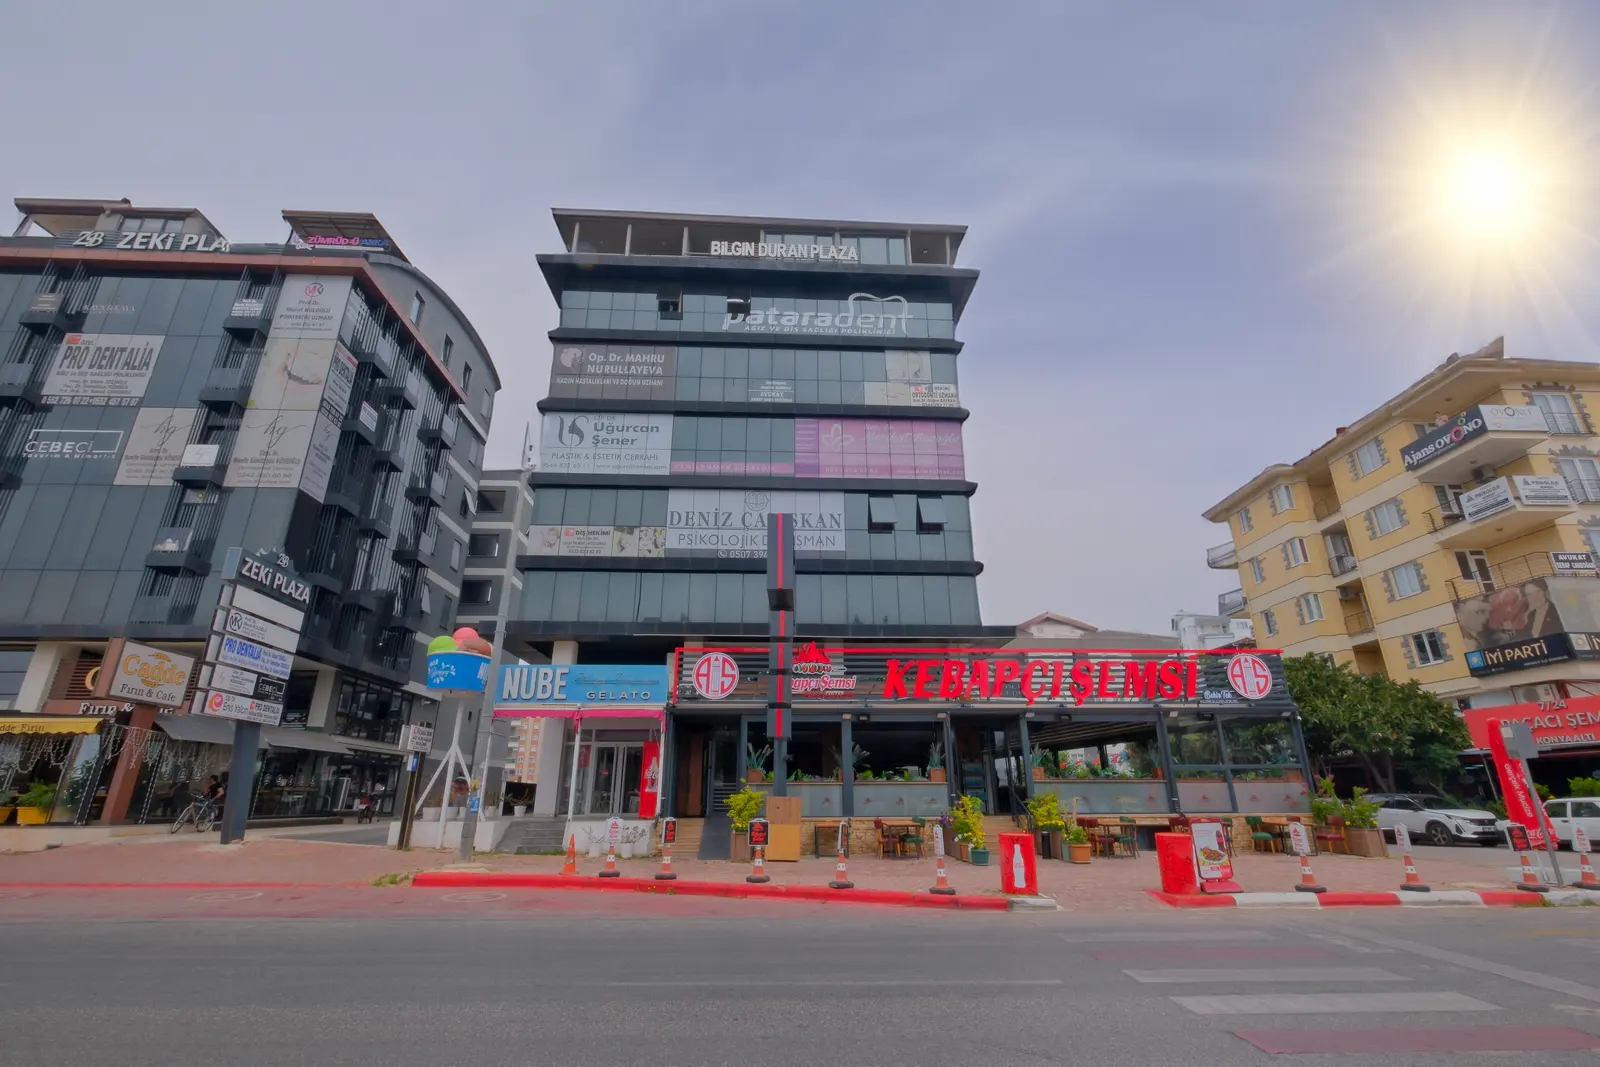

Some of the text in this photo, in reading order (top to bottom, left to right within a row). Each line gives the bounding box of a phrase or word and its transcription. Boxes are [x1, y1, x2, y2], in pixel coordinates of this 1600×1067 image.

[180, 234, 231, 252] PLA
[758, 243, 808, 259] DURAN
[811, 245, 858, 260] PLAZA
[59, 346, 91, 370] PRO
[588, 353, 665, 363] Op. Dr. MAHRU
[587, 364, 663, 376] NURULLAYEVA
[593, 422, 660, 435] Uğurcan
[592, 434, 638, 448] Şener
[1404, 444, 1436, 466] Ajans
[1435, 418, 1483, 449] OVONO
[669, 508, 733, 528] DENİZ
[678, 531, 758, 549] PSİKOLOJİK
[729, 551, 751, 559] 0507
[273, 573, 311, 604] PLAZA
[224, 637, 237, 655] PRO
[1485, 640, 1548, 665] İYİ PARTİ
[123, 653, 186, 686] Cadde
[502, 667, 570, 700] NUBE
[792, 675, 857, 691] apçı Şemsi
[883, 655, 1198, 706] KEBAPÇI ŞEMSİ
[120, 683, 176, 702] Fırın & Cafe
[586, 691, 652, 701] GELATO
[121, 702, 135, 712] &
[1565, 711, 1600, 730] ŞEM
[1536, 733, 1597, 745] KONYAALTI
